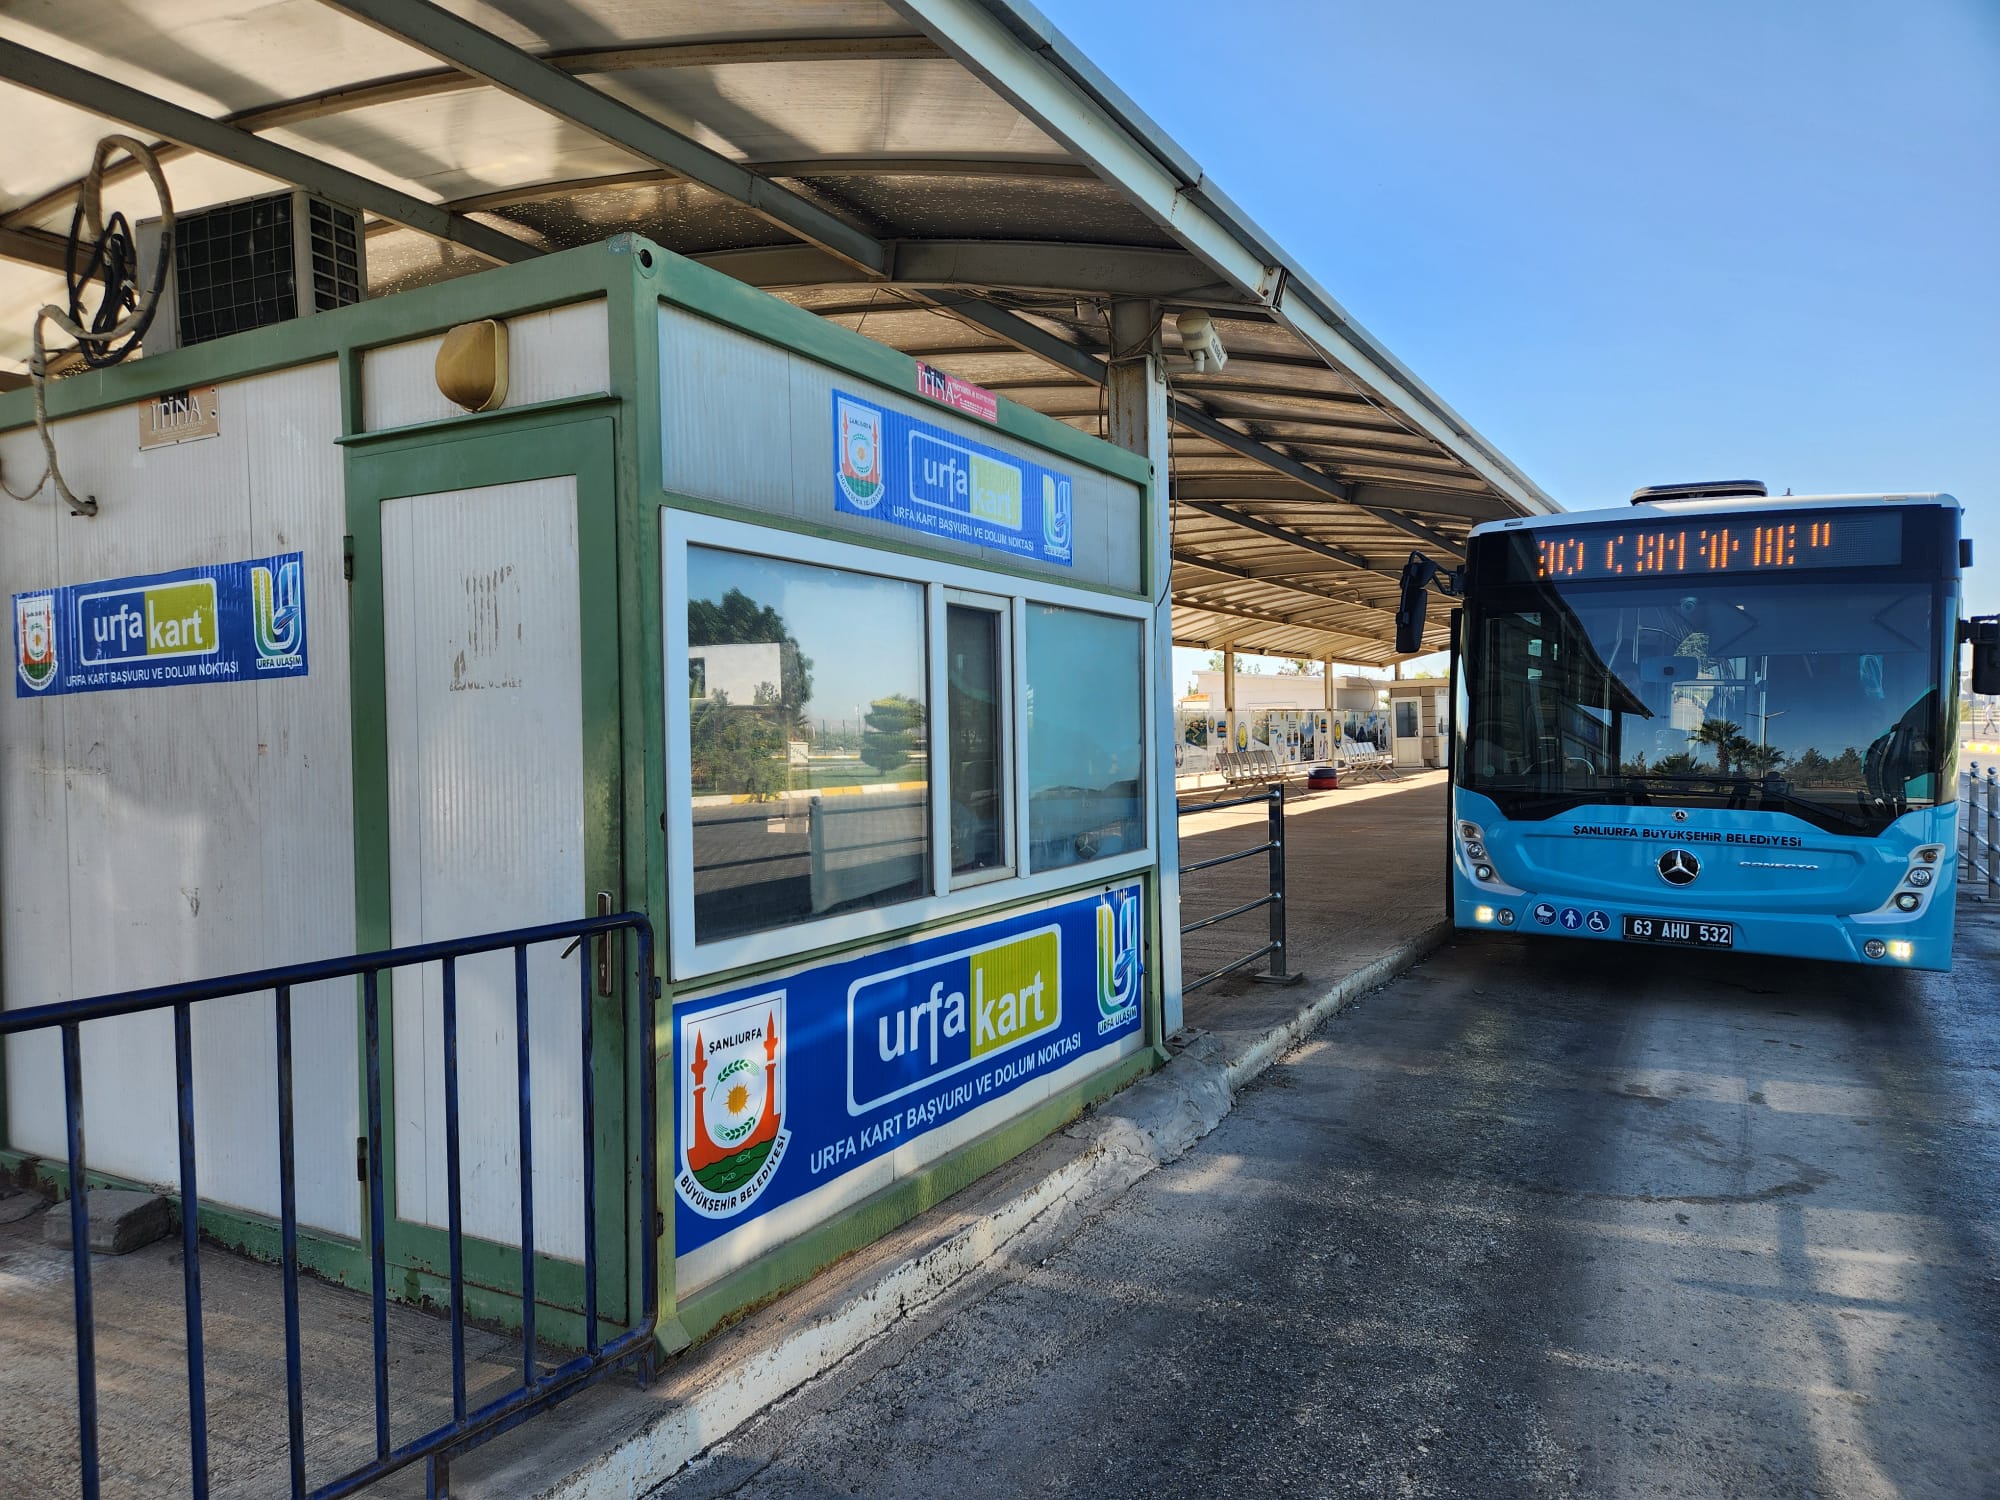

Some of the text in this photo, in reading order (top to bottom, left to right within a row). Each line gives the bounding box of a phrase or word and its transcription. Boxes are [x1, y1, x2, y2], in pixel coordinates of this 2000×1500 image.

[893, 505, 915, 522] URFA
[916, 510, 937, 527] KART
[938, 515, 973, 537] BAŞVURU
[973, 526, 984, 538] VE
[984, 528, 1008, 545] DOLUM
[93, 599, 204, 653] urfa kart
[66, 674, 88, 688] URFA
[88, 672, 110, 686] KART
[110, 669, 150, 686] BAŞVURU
[151, 668, 165, 681] VE
[165, 665, 197, 679] DOLUM
[198, 661, 240, 676] NOKTASI
[257, 656, 302, 669] URFA ULAŞIM
[1573, 824, 1802, 848] ŞANLIURFA BÜYÜKŞEHİR BELEDİYESİ
[1633, 919, 1652, 936] 63
[1661, 922, 1690, 940] AHU
[1699, 925, 1729, 943] 532
[878, 967, 1045, 1066] urfa kart
[1099, 1007, 1138, 1034] URFA ULAŞIM
[709, 1026, 763, 1055] ŞANLIURFA
[810, 1031, 1082, 1176] URFA KART BAŞVURU VE DOLUM NOKTASI
[680, 1134, 787, 1213] BÜYÜKŞEHİR BELEDİYESİ
